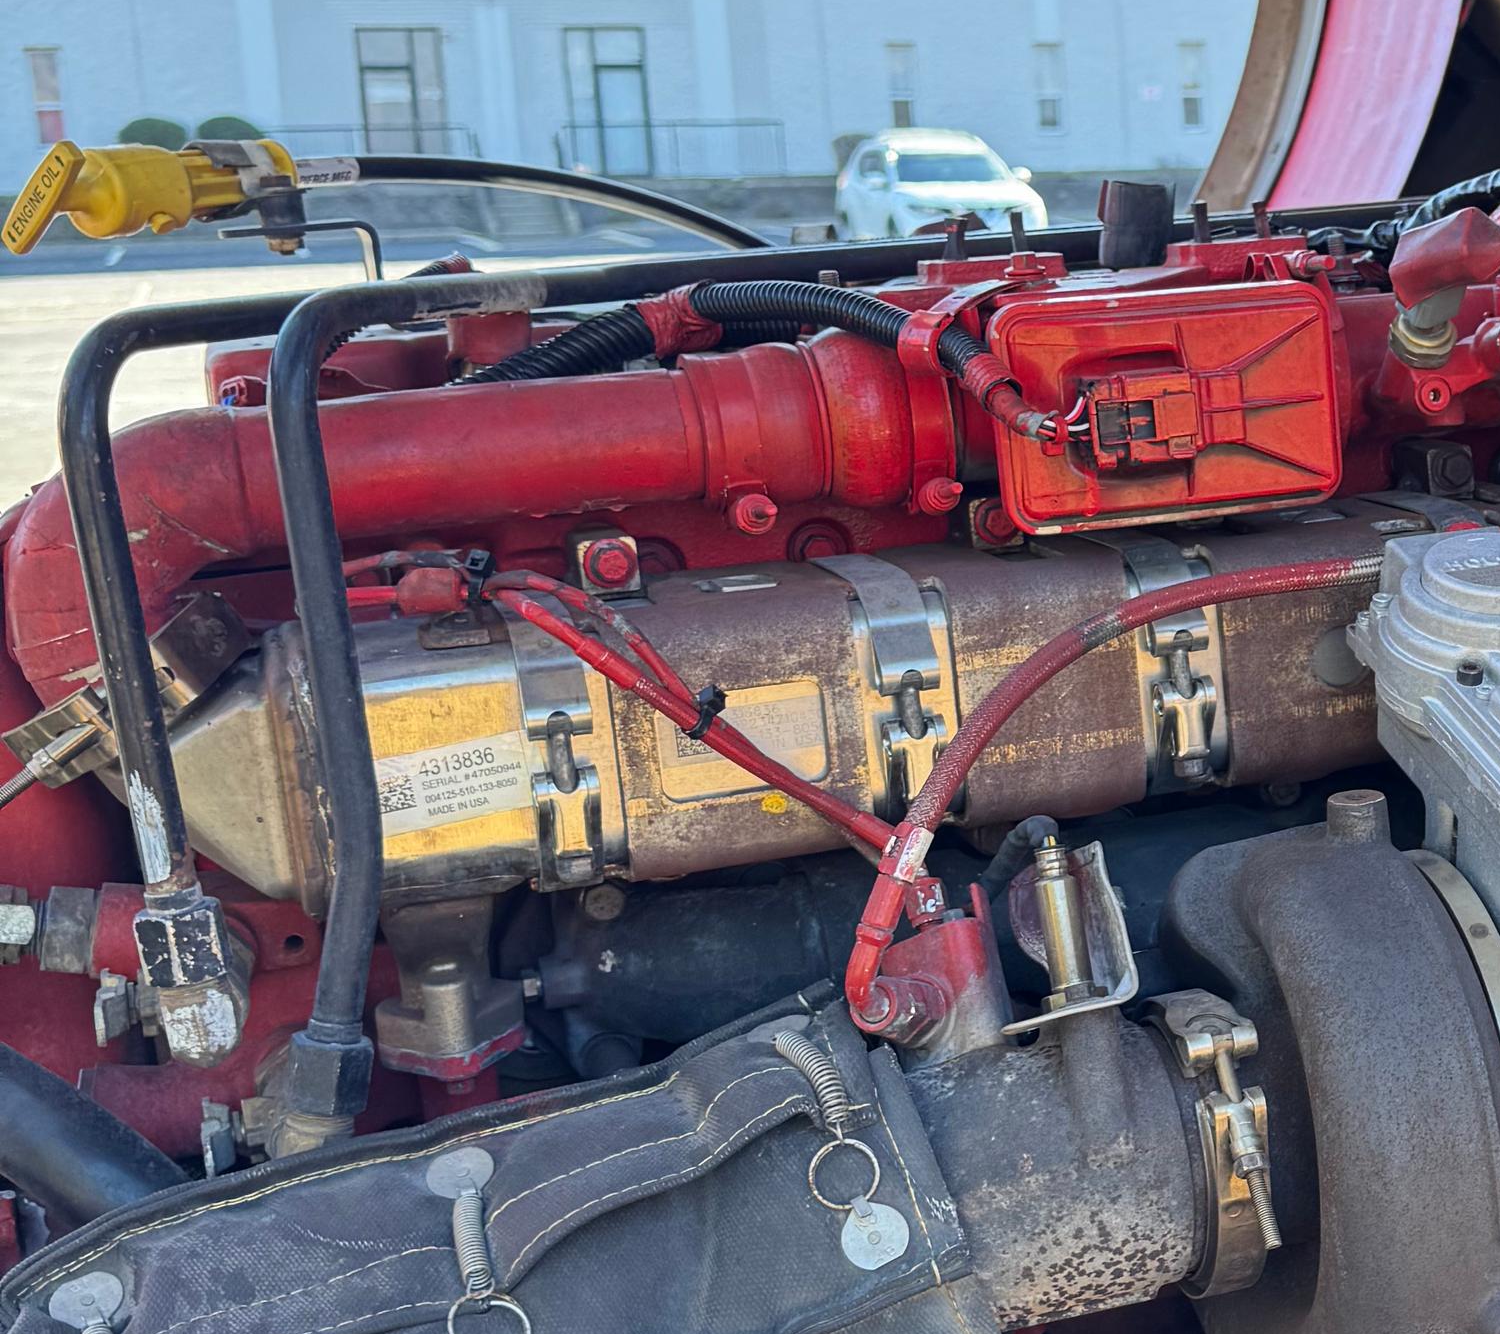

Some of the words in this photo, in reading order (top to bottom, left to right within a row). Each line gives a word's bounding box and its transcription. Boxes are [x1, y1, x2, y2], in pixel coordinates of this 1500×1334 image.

[12, 185, 46, 237] ENGINE
[41, 167, 60, 188] OIL
[419, 747, 495, 776] 4313836
[422, 775, 462, 790] SERIAL
[428, 803, 456, 816] MADE
[457, 800, 468, 811] IN
[470, 796, 490, 807] USA
